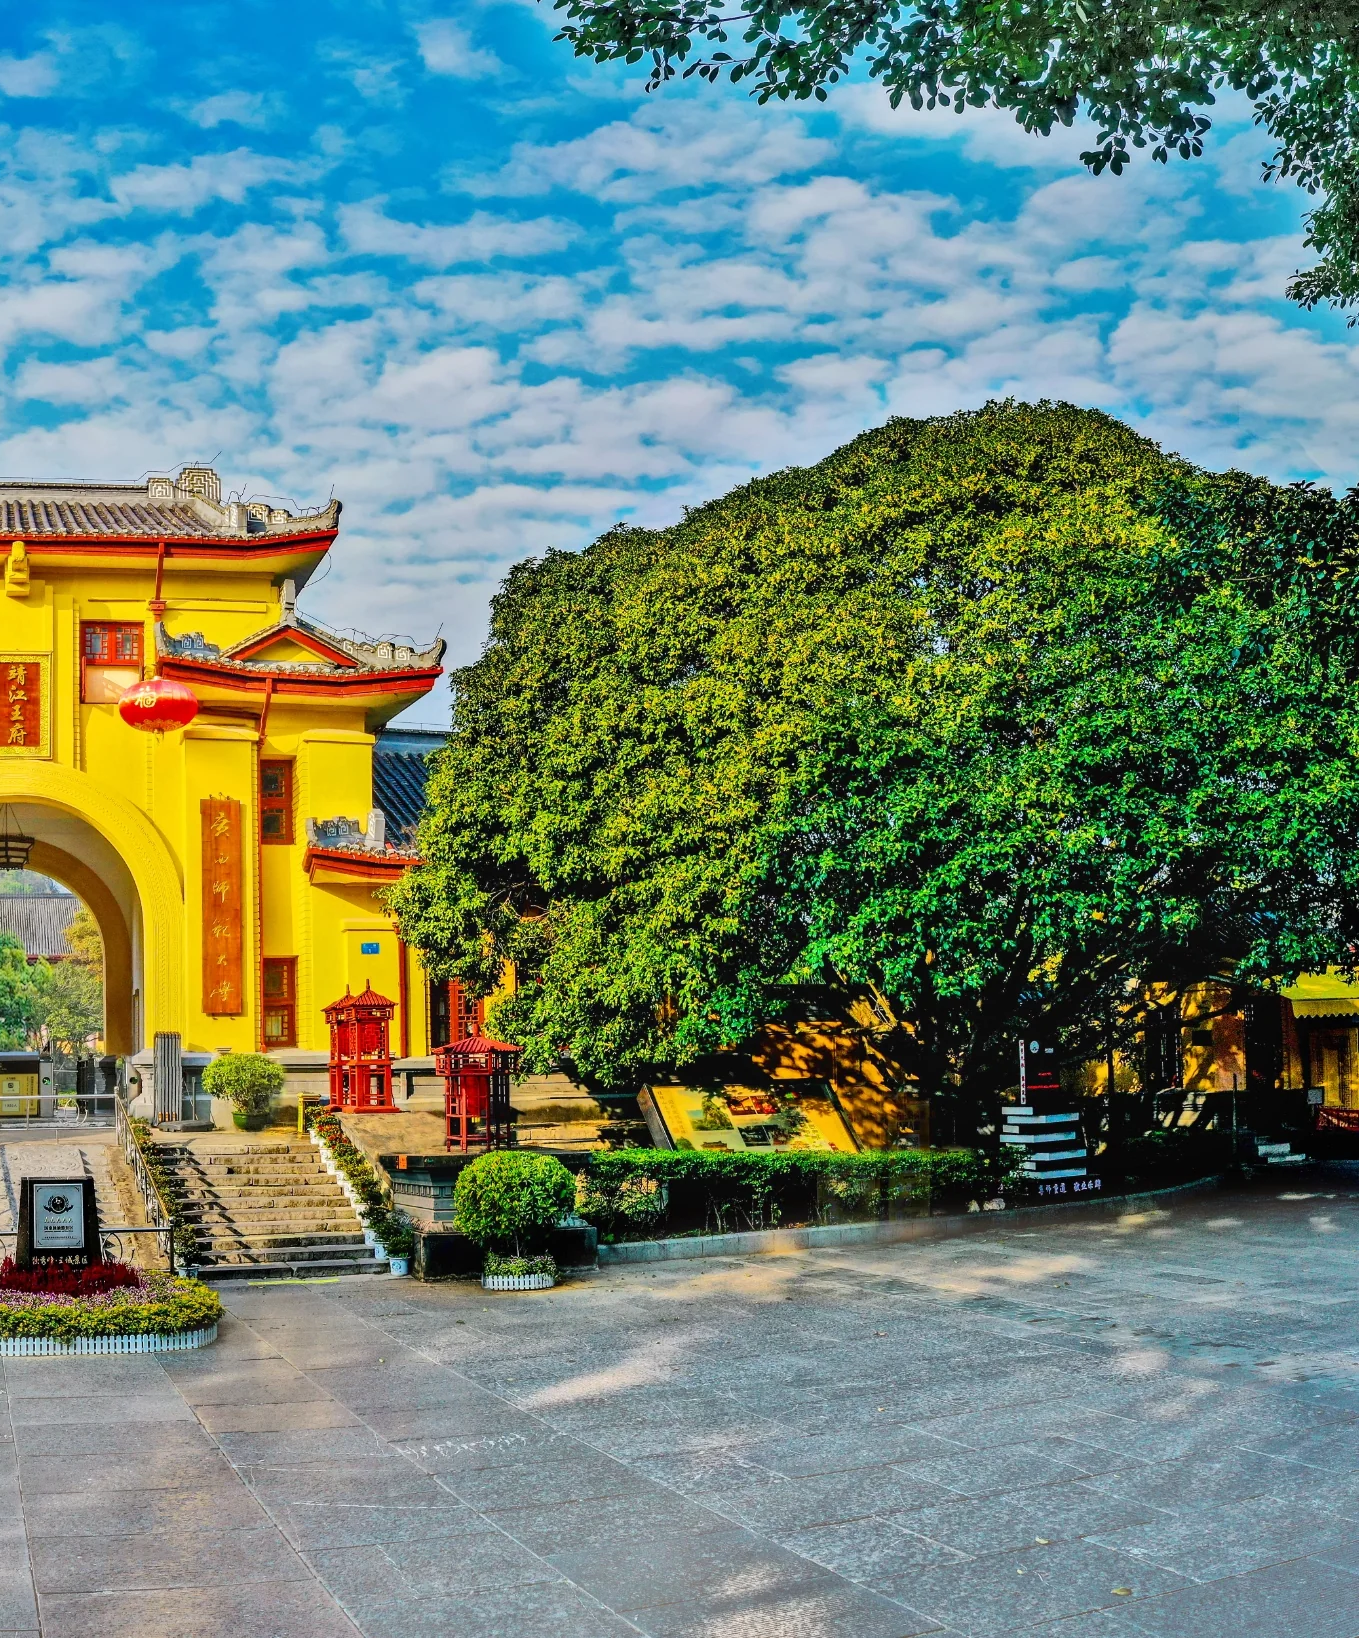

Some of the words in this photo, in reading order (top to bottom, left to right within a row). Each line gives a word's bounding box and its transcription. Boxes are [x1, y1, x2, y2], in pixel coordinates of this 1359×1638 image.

[7, 664, 28, 746] 靖江王府
[134, 686, 157, 709] 福
